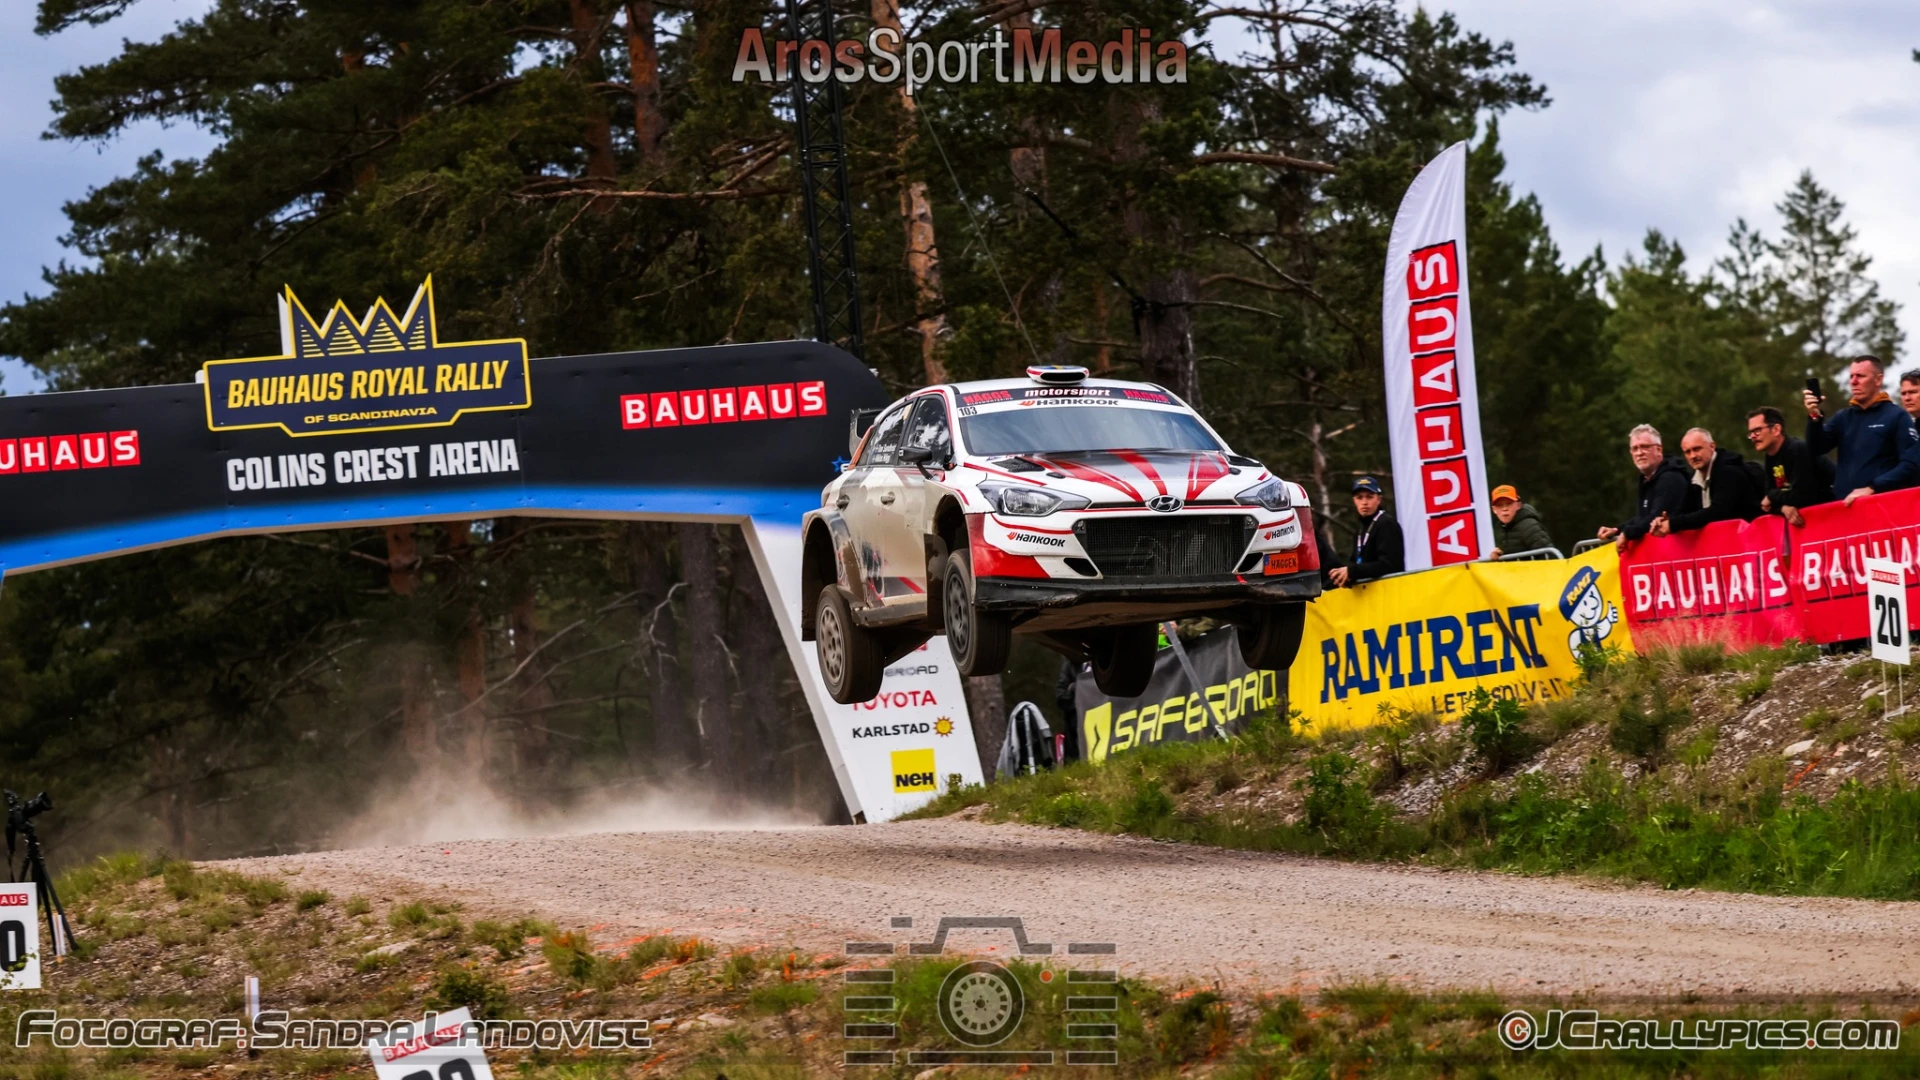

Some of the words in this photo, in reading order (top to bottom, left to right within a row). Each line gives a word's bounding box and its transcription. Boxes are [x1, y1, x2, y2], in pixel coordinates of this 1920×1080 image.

[227, 371, 344, 408] BAUHAUS
[350, 366, 429, 399] ROYAL
[434, 360, 509, 393] RALLY
[624, 386, 823, 424] BAUHAUS
[1024, 387, 1111, 397] motorsport
[304, 415, 325, 424] OF
[327, 407, 438, 422] SCANDINAVIA
[959, 406, 978, 416] 103
[226, 453, 327, 491] COLINS
[333, 446, 421, 483] CREST
[428, 438, 520, 477] ARENA
[1802, 534, 1920, 592] BAUHA
[1874, 594, 1902, 648] 20
[1320, 602, 1549, 705] RAMIRENT
[852, 722, 930, 739] KARLSTAD
[1111, 669, 1277, 754] SAFEROAD
